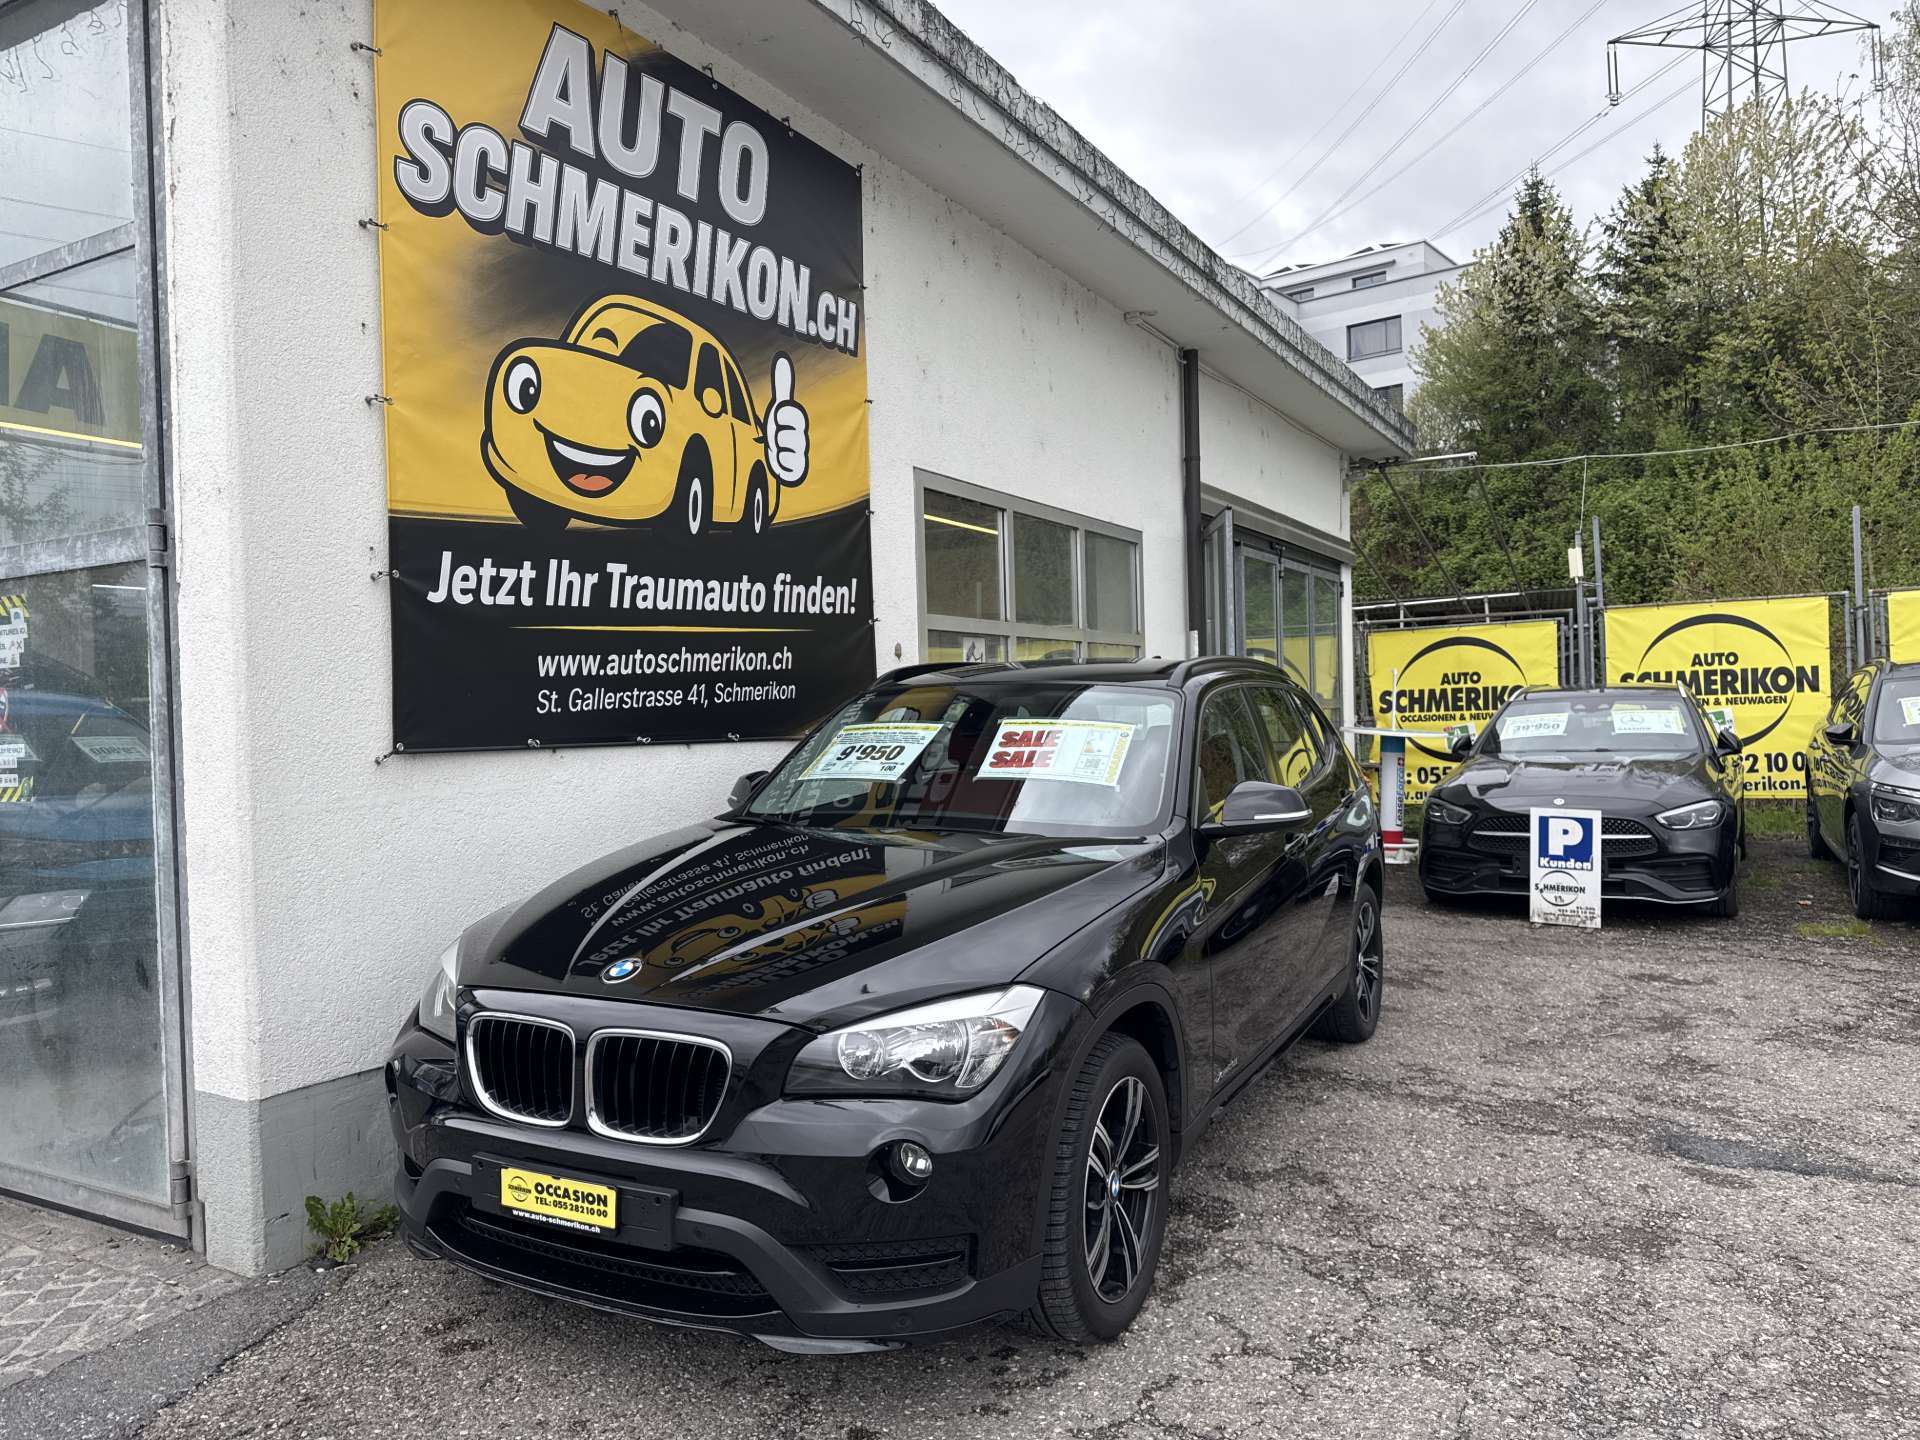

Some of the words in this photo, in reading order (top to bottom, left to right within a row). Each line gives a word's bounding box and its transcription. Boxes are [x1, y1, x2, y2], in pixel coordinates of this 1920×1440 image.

[521, 23, 770, 227] AUTO
[395, 99, 858, 356] SCHMERIKON.CH
[426, 551, 536, 606] Jetzt
[545, 559, 598, 608] Ihr
[606, 562, 767, 613] Traumauto
[773, 572, 857, 614] finden!
[537, 646, 793, 677] www.autoschmerikon.ch
[1691, 652, 1739, 667] AUTO
[1440, 671, 1481, 686] AUTO
[536, 689, 562, 714] St.
[568, 684, 682, 711] Gallerstrasse
[687, 684, 709, 708] 41,
[714, 681, 796, 703] Schmerikon
[1713, 697, 1721, 706] &
[1726, 695, 1788, 706] NEUWAGEN
[1400, 712, 1456, 723] OCCASIONEN
[1459, 711, 1467, 721] &
[998, 729, 1063, 748] SALE
[836, 744, 905, 761] 9'950
[989, 750, 1054, 768] SALE
[1539, 857, 1592, 871] Kunden
[1534, 883, 1586, 894] SHMERIKON
[534, 1182, 608, 1208] OCCASION
[534, 1196, 552, 1206] TEL:
[553, 1200, 568, 1210] 055
[512, 1209, 601, 1233] www.auto-schmerikon.ch
